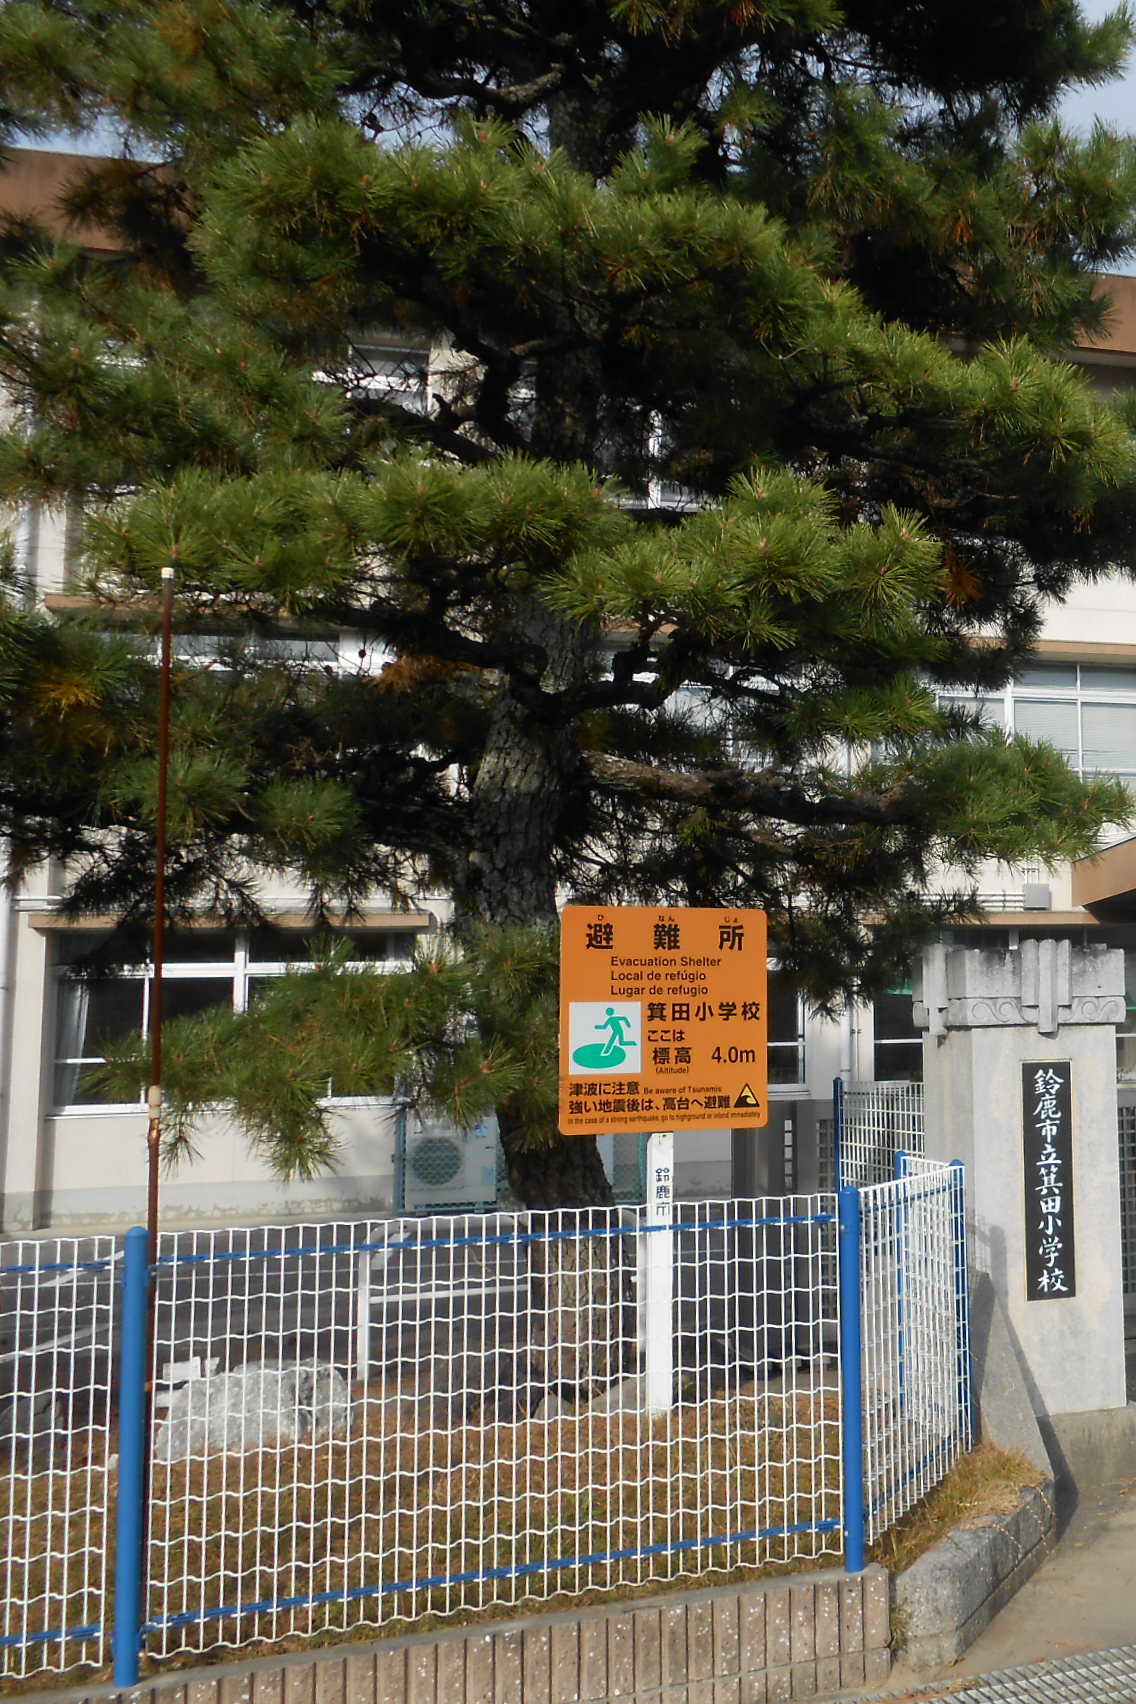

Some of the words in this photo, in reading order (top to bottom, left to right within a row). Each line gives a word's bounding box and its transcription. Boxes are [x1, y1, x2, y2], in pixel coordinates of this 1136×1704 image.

[586, 922, 744, 951] 避難所
[611, 956, 677, 967] Evacuation
[680, 956, 721, 967] Shelter
[611, 971, 643, 981] Local
[647, 971, 661, 981] de
[665, 970, 706, 982] refúgio
[611, 985, 645, 997] Lugar
[649, 985, 662, 995] de
[667, 985, 708, 997] refugio
[647, 1001, 760, 1021] 箕田小学校
[647, 1029, 685, 1042] ここは
[652, 1046, 692, 1065] 標高
[711, 1046, 756, 1063] 4.0m
[655, 1066, 689, 1074] (Altitude)
[569, 1081, 640, 1096] 津波に注意
[688, 1085, 722, 1093] Tsunamis
[569, 1095, 731, 1114] 強い地震後は、高台へ避難
[1032, 1068, 1069, 1293] 鈴鹿市立箕田小学校
